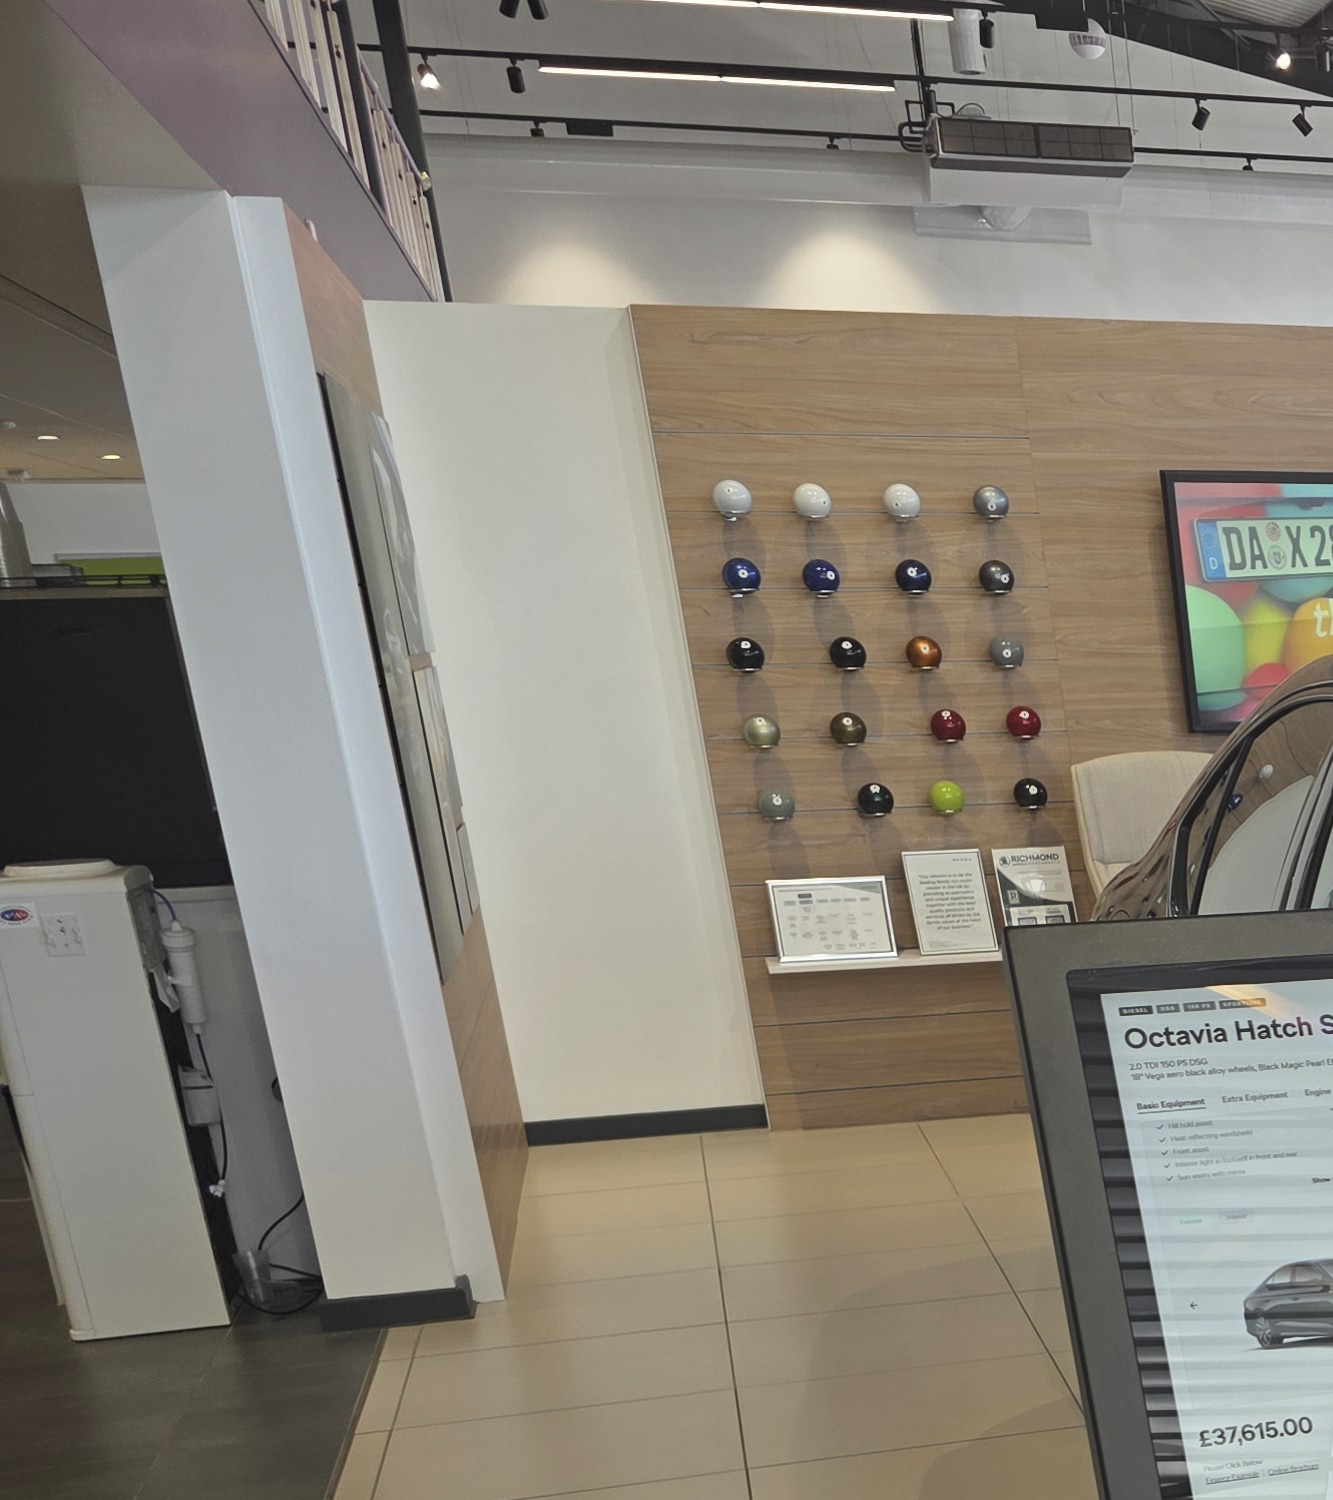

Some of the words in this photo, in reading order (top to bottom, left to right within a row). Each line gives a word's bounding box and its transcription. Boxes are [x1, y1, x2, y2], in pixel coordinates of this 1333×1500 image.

[1221, 525, 1269, 571] DA
[1289, 525, 1309, 567] X
[1011, 853, 1060, 862] RICHMOND
[1123, 1022, 1227, 1048] Octavia
[1234, 1016, 1312, 1040] Hatch
[1129, 1062, 1142, 1070] 2.0
[1144, 1061, 1158, 1069] TDI
[1160, 1060, 1175, 1068] 150
[1189, 1057, 1207, 1065] DSG
[1145, 1071, 1164, 1081] Vega
[1185, 1068, 1206, 1076] black
[1208, 1066, 1226, 1076] alloy
[1227, 1064, 1257, 1074] wheels,
[1258, 1062, 1279, 1070] Black
[1280, 1060, 1304, 1070] Magic
[1305, 1059, 1325, 1067] Pearl
[1221, 1094, 1243, 1103] Extra
[1244, 1091, 1288, 1102] Equipment
[1304, 1087, 1331, 1097] Engine
[1136, 1101, 1159, 1110] Basic
[1160, 1098, 1205, 1109] Equipment
[1197, 1417, 1314, 1446] £37,615.00
